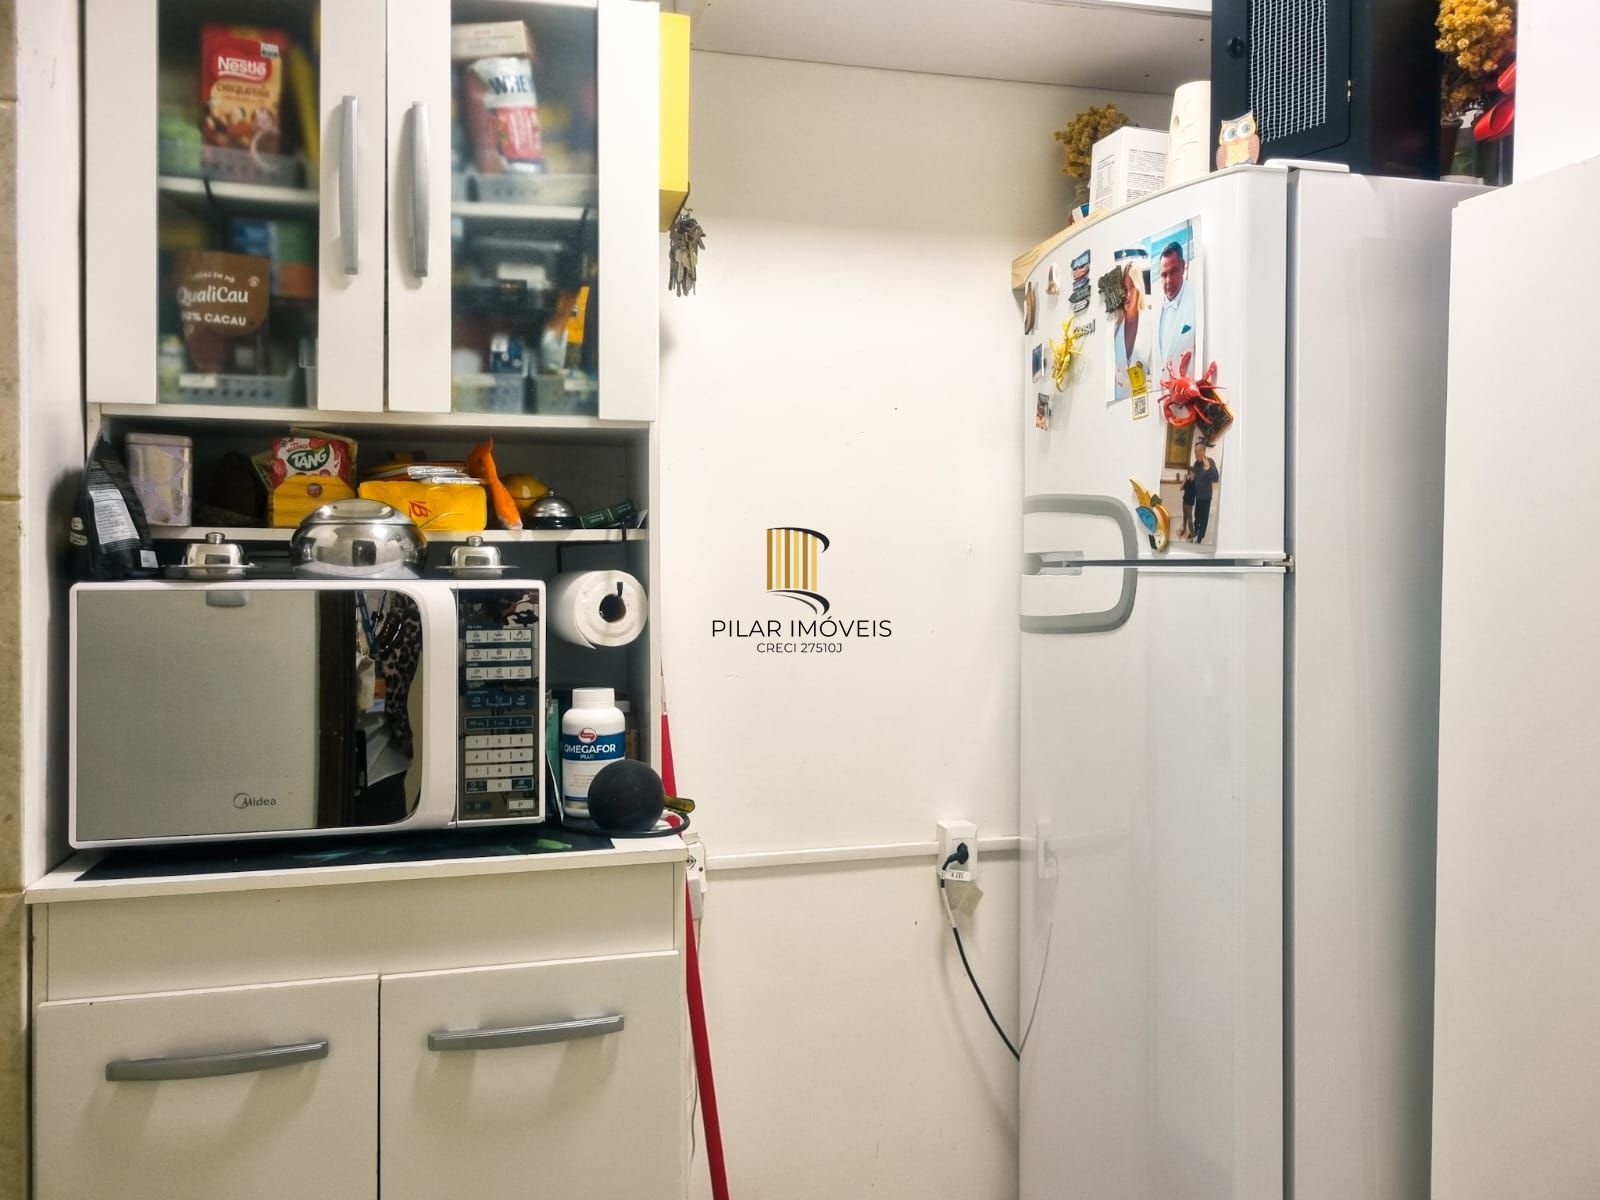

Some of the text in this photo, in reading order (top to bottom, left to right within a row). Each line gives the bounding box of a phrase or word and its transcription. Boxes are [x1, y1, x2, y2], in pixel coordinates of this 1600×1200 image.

[176, 284, 249, 307] QualiCau
[204, 312, 247, 327] CACAU
[291, 448, 328, 470] TANG
[563, 743, 616, 755] OMEGAFOR
[233, 792, 277, 809] Midea
